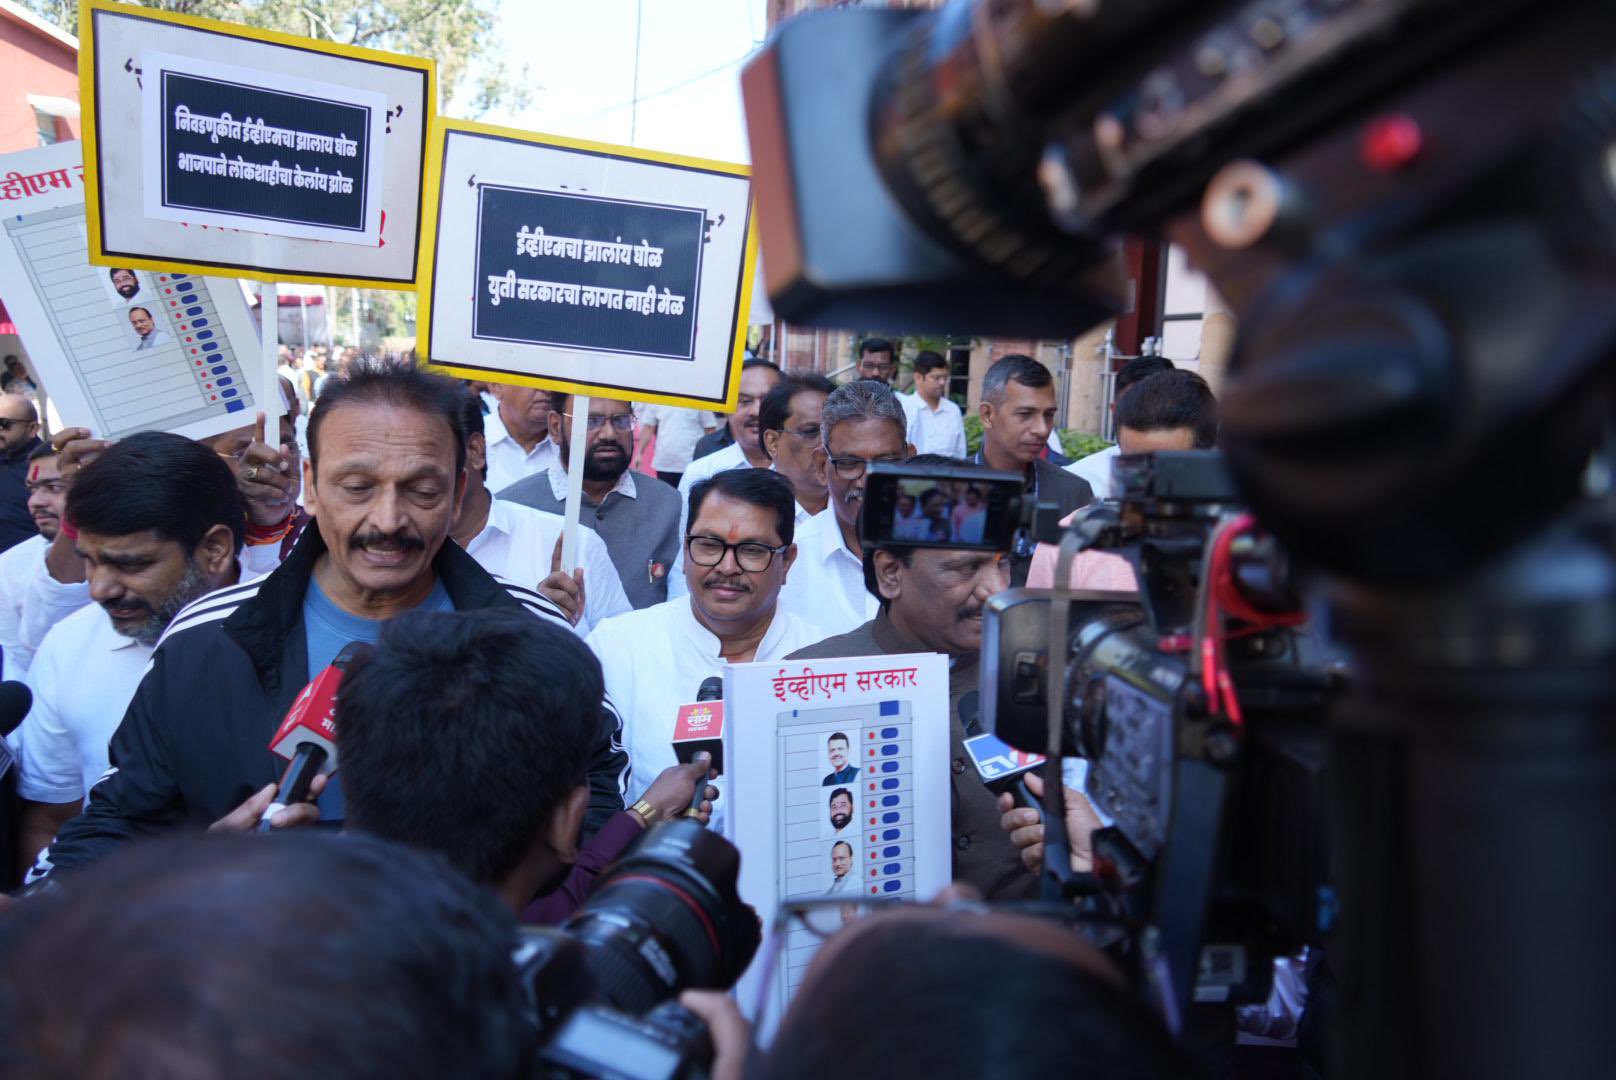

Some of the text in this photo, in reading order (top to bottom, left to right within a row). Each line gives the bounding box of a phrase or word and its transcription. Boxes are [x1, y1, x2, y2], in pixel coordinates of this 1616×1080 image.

[174, 104, 358, 157] निवडणूकीत ईव्हीएमचा झालाय घोळ
[178, 152, 354, 194] भाजपाने लोकशाहीचा केलांय झोळ
[516, 225, 664, 268] ईव्हीएमचा झालांय घोळ
[488, 269, 686, 316] युती सरकारचा लागत नाही मेळ
[772, 667, 918, 701] ईव्हीएम सरकार
